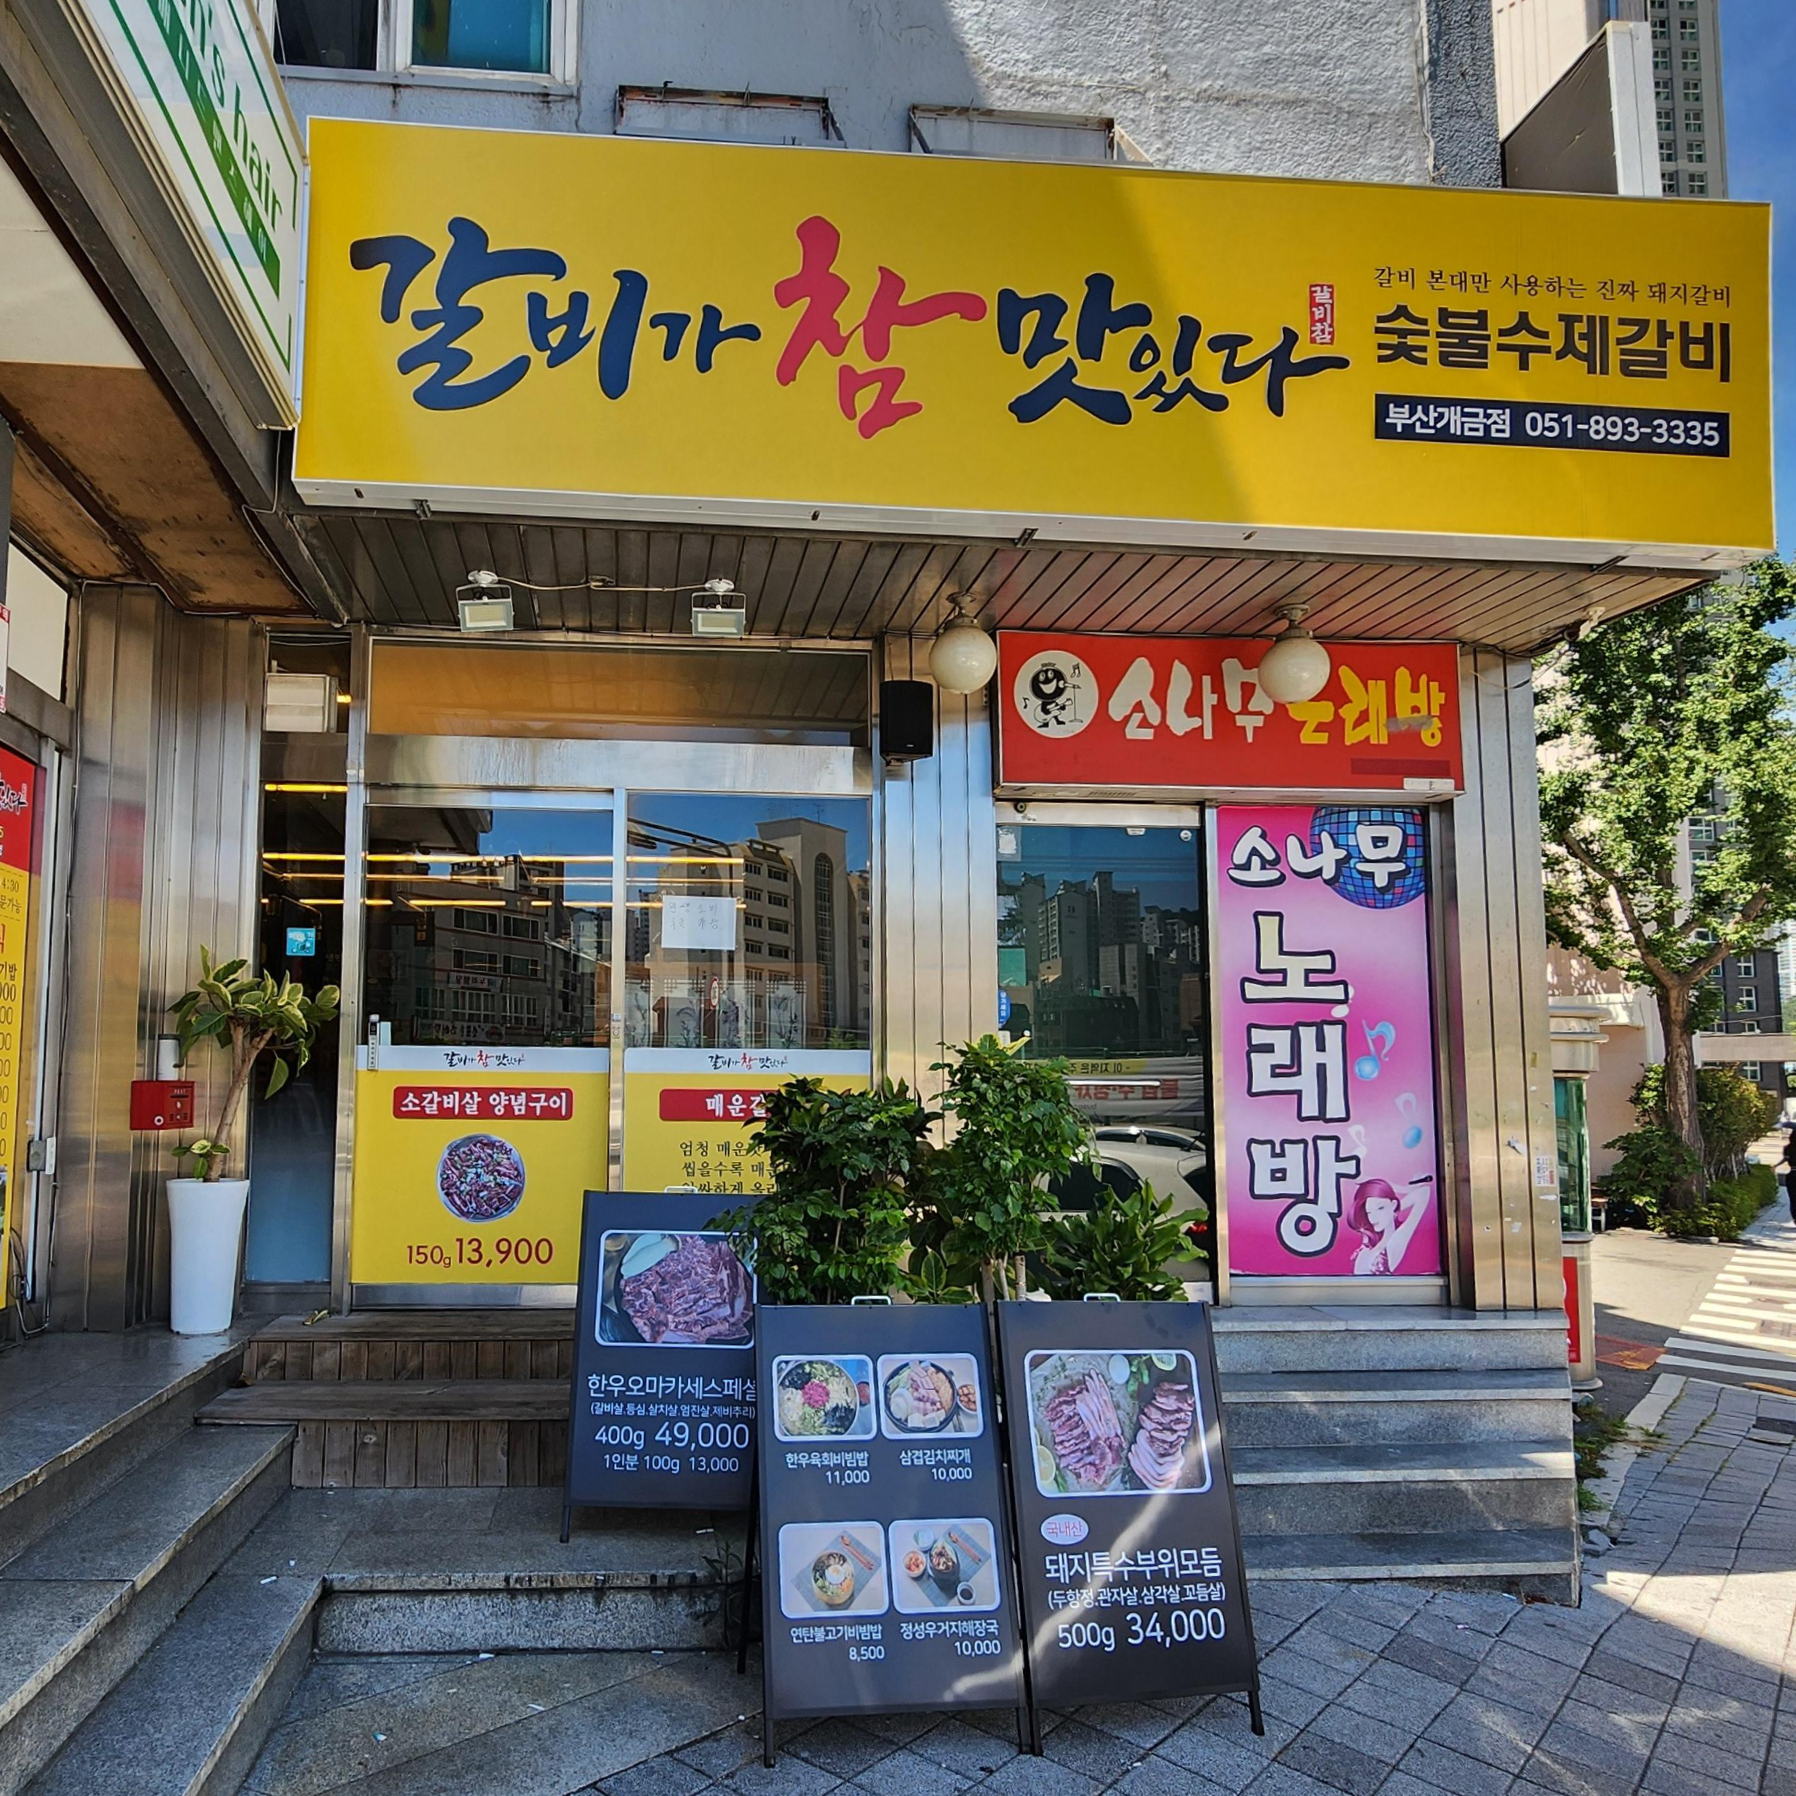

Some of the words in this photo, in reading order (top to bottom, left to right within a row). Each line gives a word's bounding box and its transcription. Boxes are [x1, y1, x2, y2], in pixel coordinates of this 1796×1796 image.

[233, 82, 283, 233] hair
[1374, 266, 1416, 290] 갈비
[1426, 269, 1492, 293] 본대만
[1500, 273, 1588, 299] 사용하는
[1596, 278, 1639, 303] 진짜
[1647, 282, 1731, 308] 돼지갈비
[1310, 285, 1333, 344] 갈비참
[349, 215, 763, 411] 갈비가
[773, 214, 988, 440] 참
[996, 271, 1352, 424] 맛있다
[1374, 303, 1731, 384] 숯불수제갈비
[1385, 403, 1511, 439] 부산개금점
[1524, 411, 1721, 447] 051-893-3335
[1226, 823, 1411, 893] 소나무
[476, 1050, 495, 1068] 참
[740, 1052, 758, 1070] 참
[1240, 911, 1361, 1258] 노래방
[400, 1090, 482, 1116] 소갈비살
[488, 1091, 567, 1117] 양념구이
[680, 1141, 709, 1157] 엄청
[682, 1160, 744, 1177] 씹을수록
[406, 1245, 452, 1268] 150g
[455, 1237, 554, 1268] 13,900
[587, 1373, 756, 1402] 한우오마카세스페셜
[594, 1425, 645, 1450] 400g
[654, 1421, 750, 1451] 49,000
[603, 1453, 639, 1471] 1인분
[643, 1455, 680, 1474] 100g
[688, 1457, 739, 1474] 13,000
[785, 1451, 869, 1468] 한우육회비빔밥
[899, 1448, 971, 1466] 삼겹김치찌개
[826, 1470, 870, 1486] 11,000
[931, 1467, 973, 1482] 10,000
[1046, 1521, 1083, 1538] 국내산
[1044, 1547, 1223, 1584] 돼지특수부위모듬
[790, 1623, 882, 1643] 연탄불고기비빔밥
[900, 1619, 1000, 1640] 정성우거지해장국
[1058, 1622, 1116, 1651] 500g
[1125, 1607, 1226, 1648] 34,000
[849, 1645, 885, 1662] 8,500
[954, 1639, 1001, 1657] 10,000
